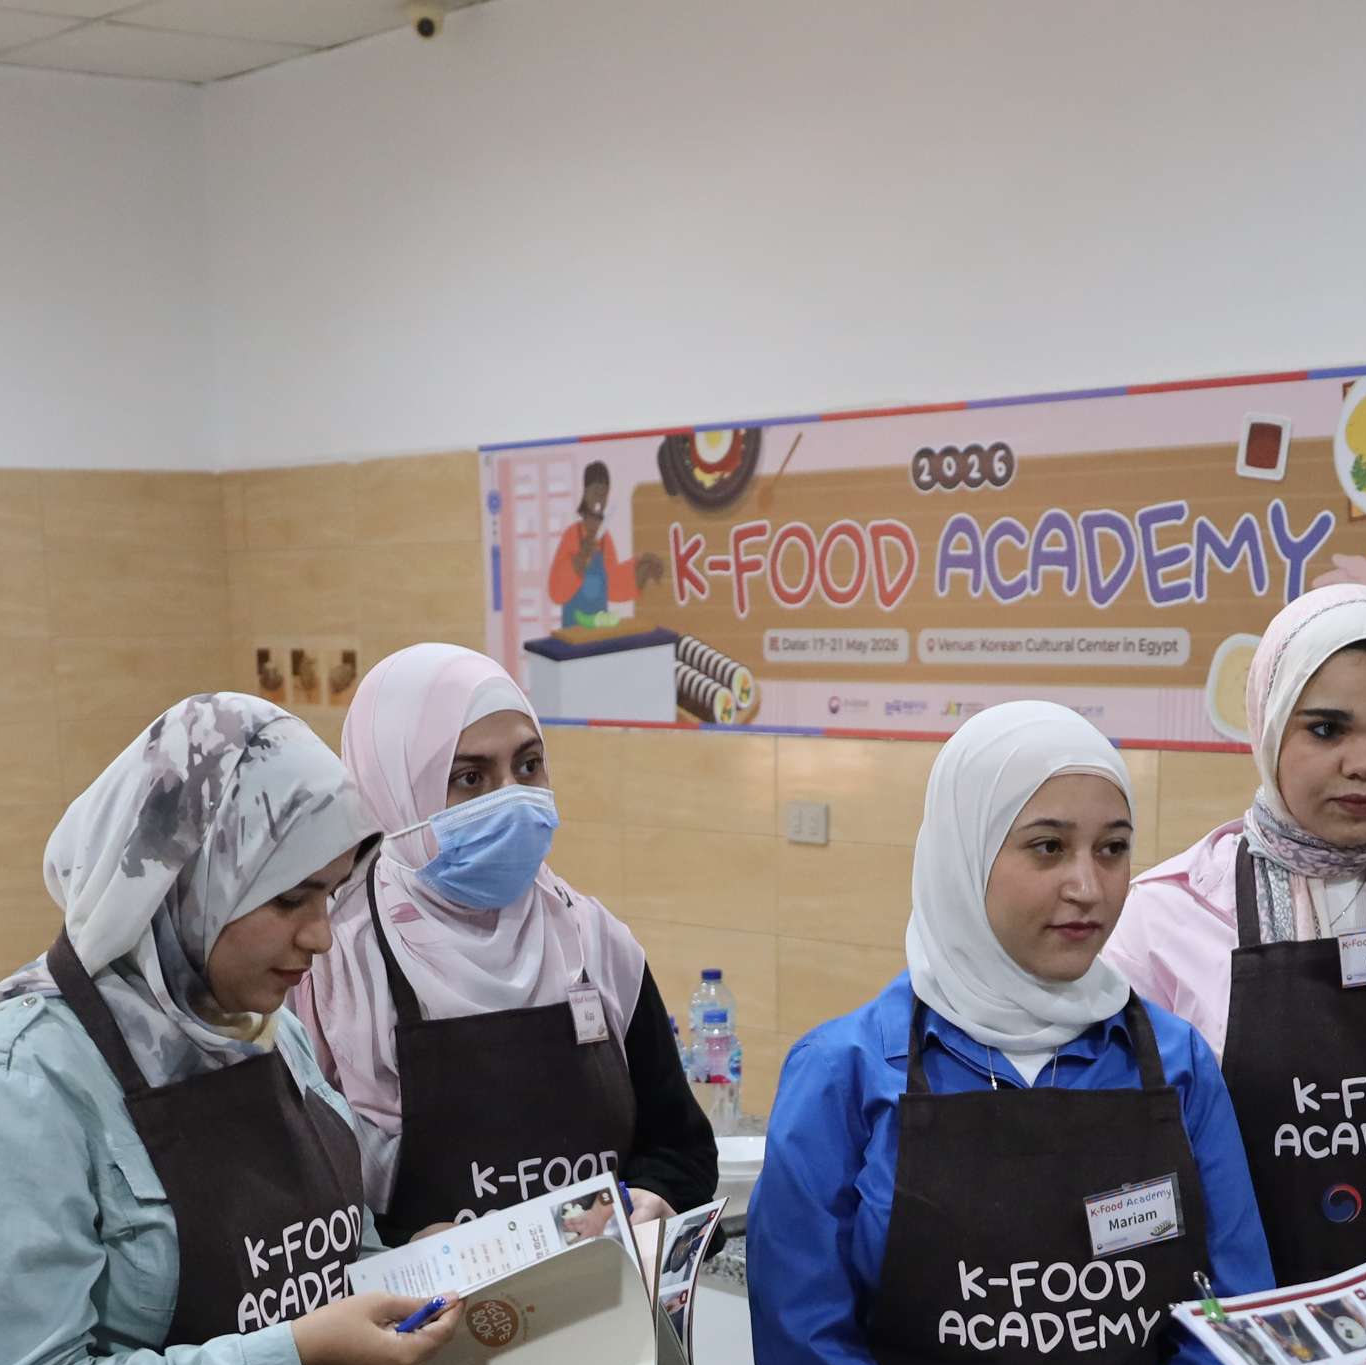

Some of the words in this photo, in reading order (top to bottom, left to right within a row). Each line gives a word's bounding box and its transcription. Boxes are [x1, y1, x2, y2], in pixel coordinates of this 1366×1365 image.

[918, 450, 1008, 482] 2026
[670, 520, 917, 616] K-FOOD
[938, 499, 1335, 607] ACADEMY
[846, 637, 868, 653] May
[870, 637, 899, 651] 2026
[980, 638, 1022, 652] Korean
[1025, 637, 1075, 653] Cultural
[1077, 638, 1121, 653] Center
[1123, 637, 1135, 652] in
[1138, 638, 1179, 657] Egypt
[1090, 1200, 1123, 1218] K-Food
[1126, 1188, 1172, 1207] Academy
[1109, 1210, 1157, 1231] Mariam
[244, 1205, 361, 1278] K-FOOD
[958, 1260, 1146, 1308] K-FOOD
[472, 1309, 495, 1340] BOOK
[483, 1301, 513, 1342] RECIPE
[939, 1306, 1161, 1353] ACADEMY
